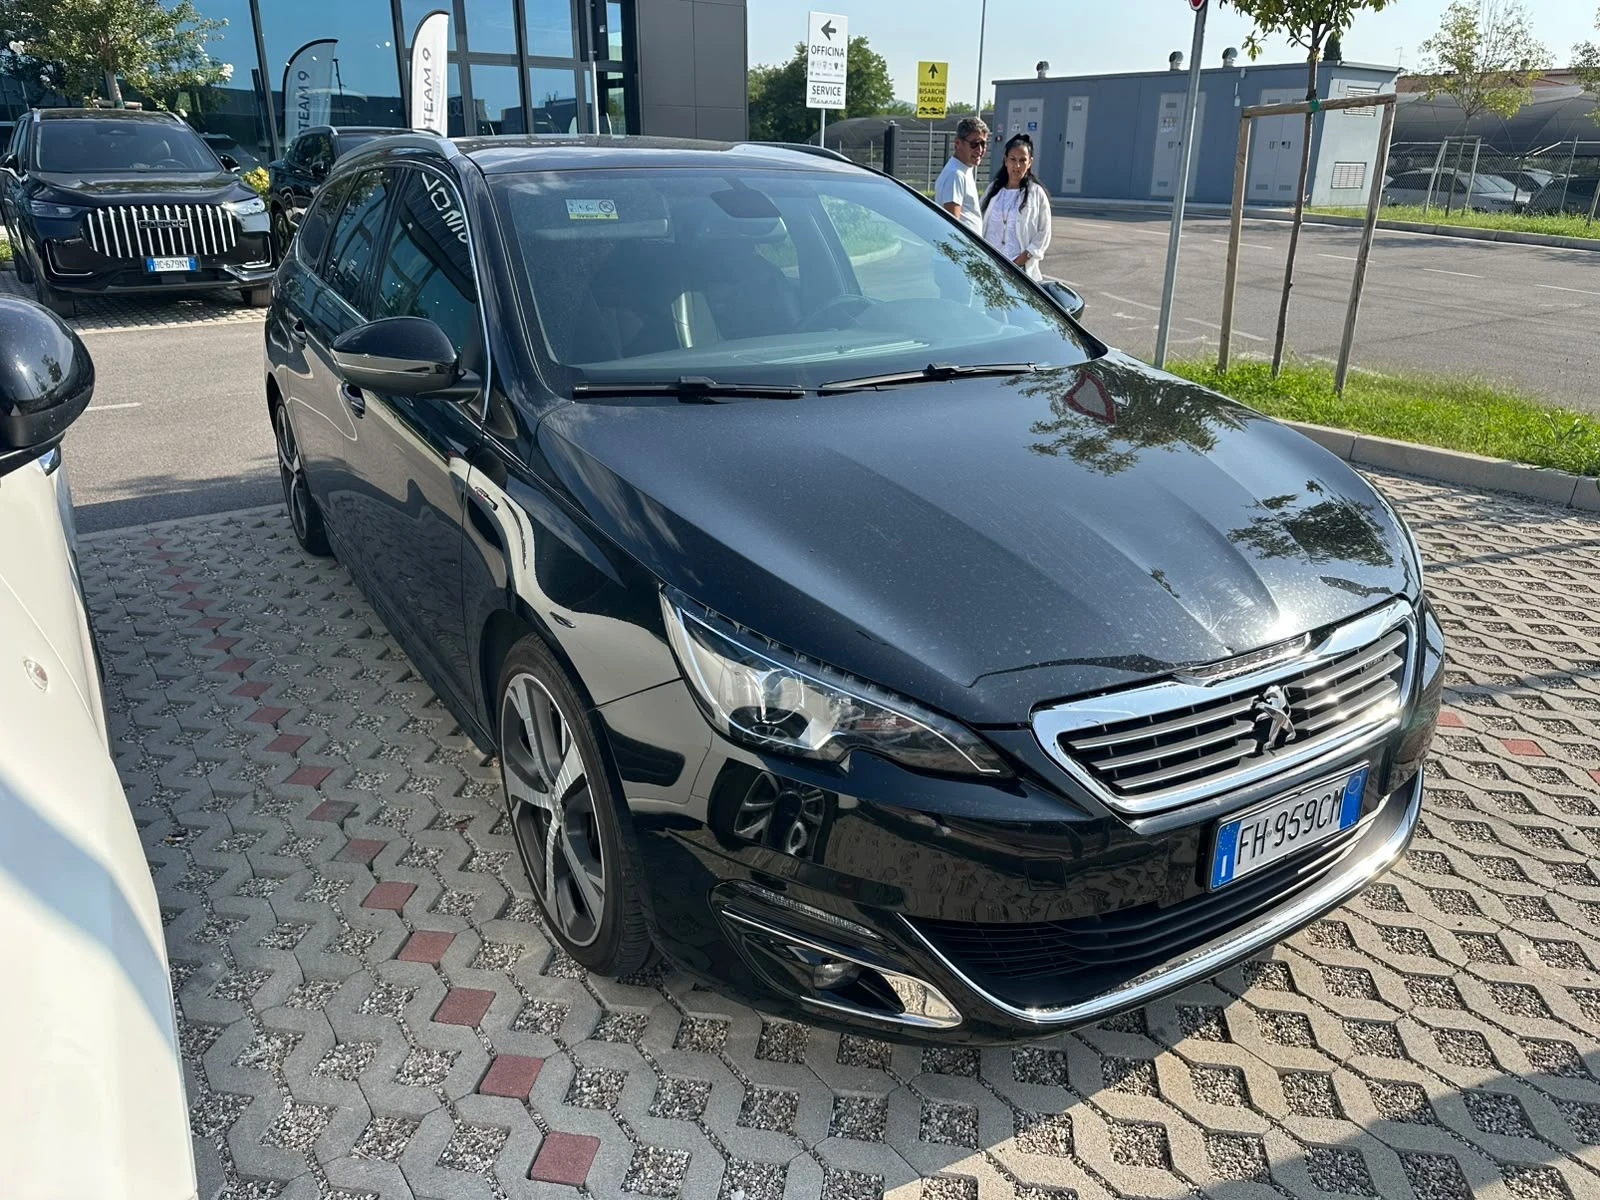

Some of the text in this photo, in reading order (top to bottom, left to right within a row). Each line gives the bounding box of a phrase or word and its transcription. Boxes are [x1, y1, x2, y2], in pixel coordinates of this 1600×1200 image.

[811, 44, 845, 58] OFFICINA
[297, 70, 310, 134] TEAM 9
[422, 47, 434, 128] TEAM 9
[811, 85, 842, 97] SERVICE
